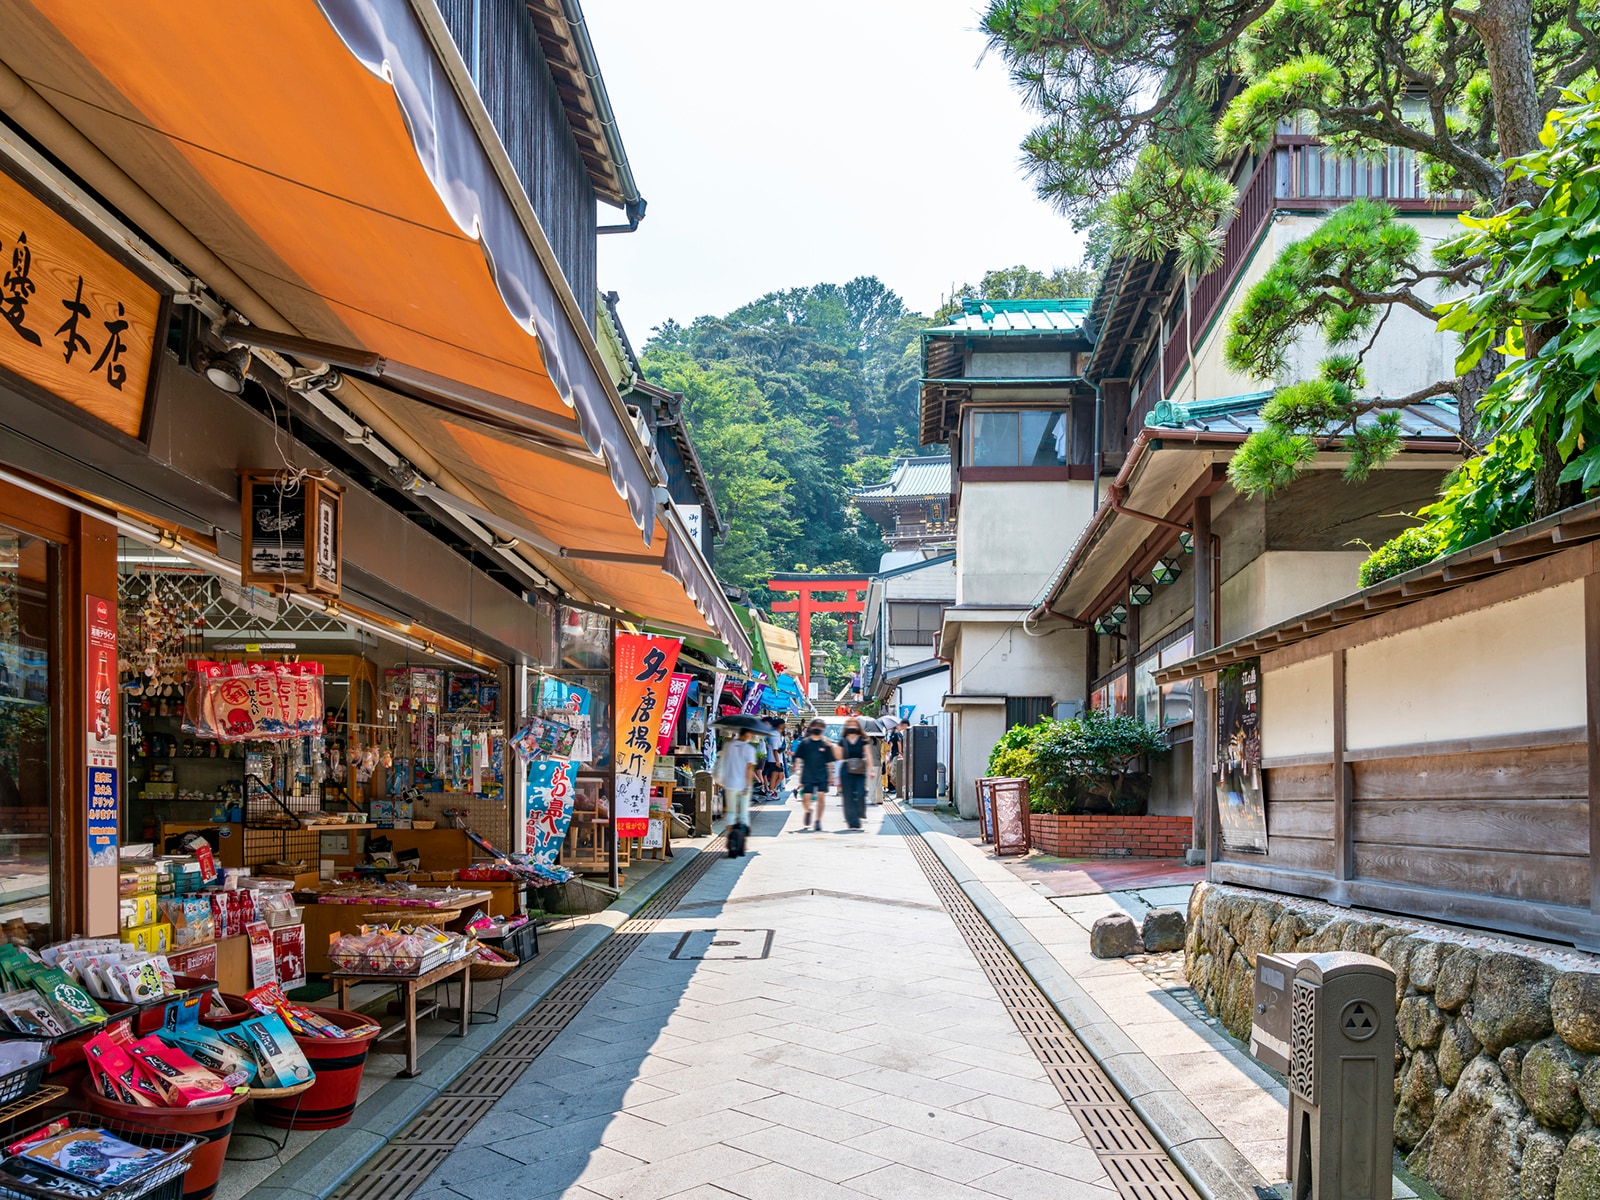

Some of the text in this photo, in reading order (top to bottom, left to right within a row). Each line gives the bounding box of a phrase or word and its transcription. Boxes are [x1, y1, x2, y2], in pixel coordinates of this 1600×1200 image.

[247, 689, 260, 715] せんべい
[254, 678, 273, 706] たこ
[92, 796, 115, 808] ドリンク
